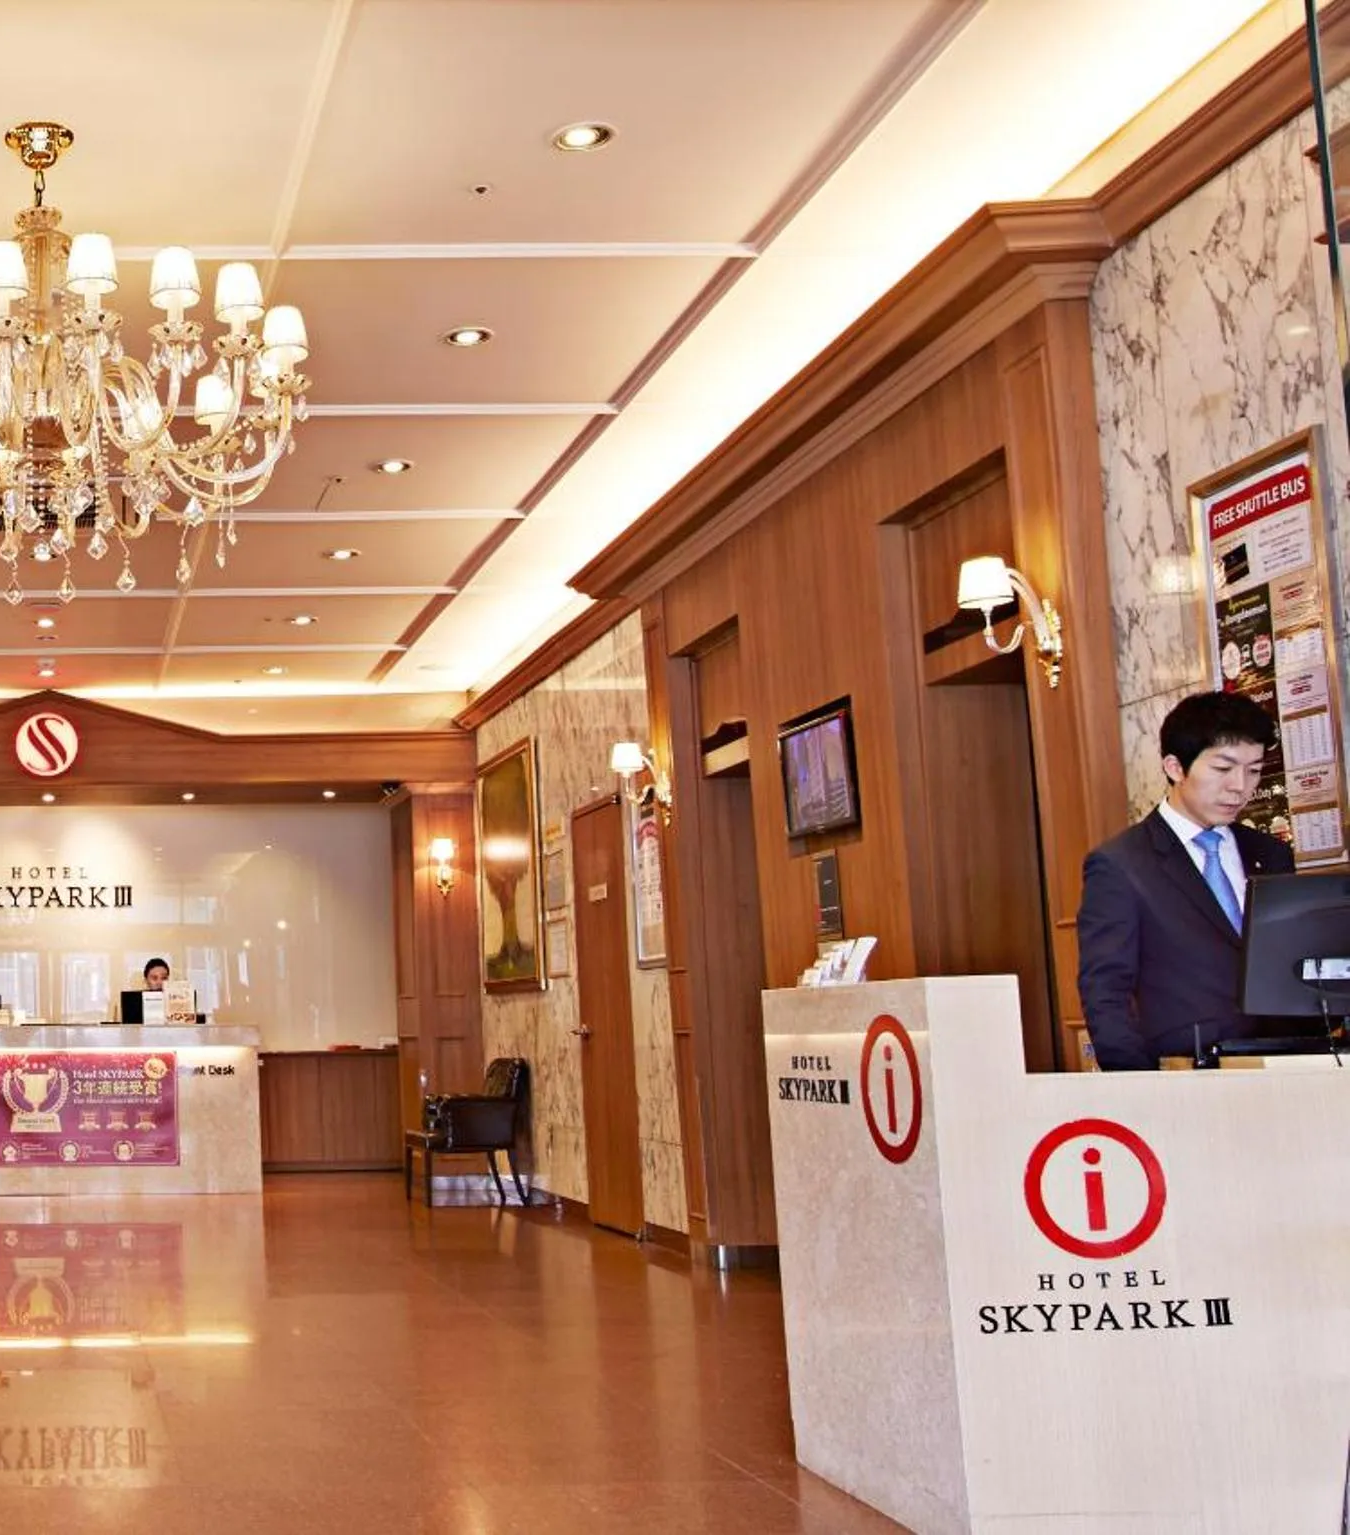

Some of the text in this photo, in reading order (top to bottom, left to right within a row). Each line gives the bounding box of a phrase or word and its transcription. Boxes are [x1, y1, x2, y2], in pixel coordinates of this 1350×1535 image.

[1213, 506, 1235, 529] FREE
[1236, 486, 1279, 518] SHUTTLE
[1280, 475, 1305, 499] BUS
[11, 867, 88, 879] HOTEL
[208, 1064, 235, 1076] Desk
[792, 1056, 832, 1071] HOTEL
[778, 1077, 839, 1104] SKYPARK
[1038, 1270, 1166, 1290] HOTEL
[979, 1300, 1195, 1334] SKYPARK
